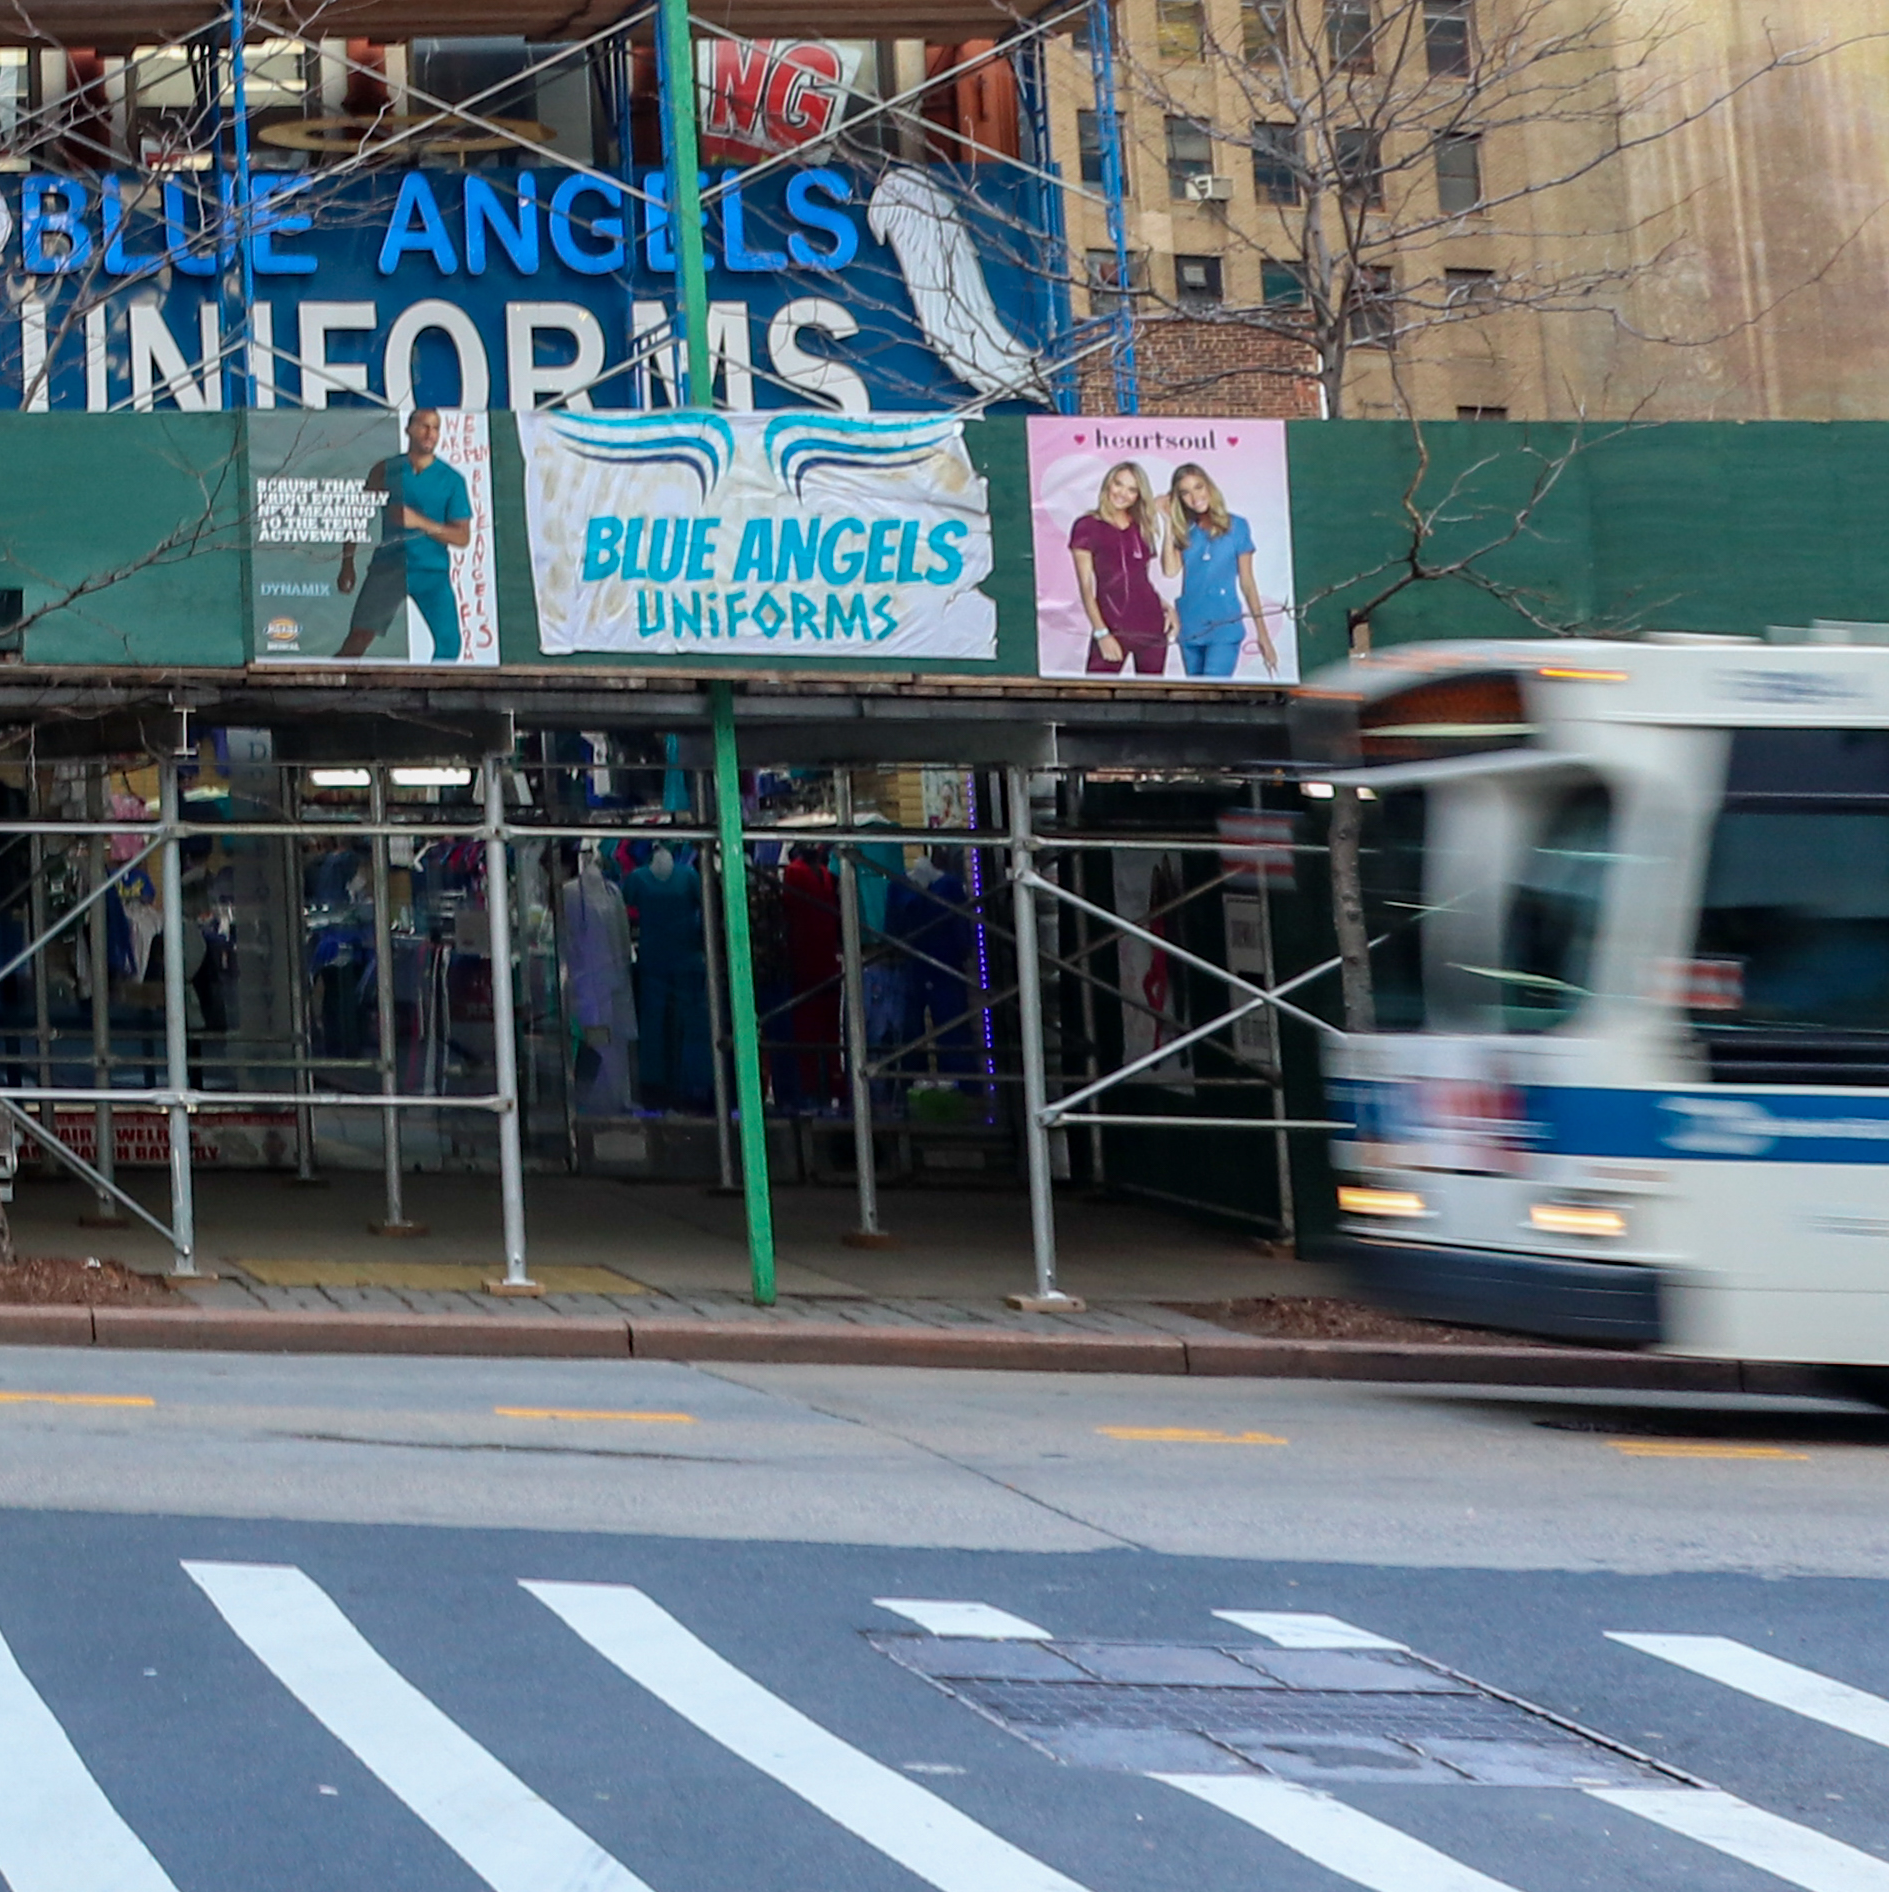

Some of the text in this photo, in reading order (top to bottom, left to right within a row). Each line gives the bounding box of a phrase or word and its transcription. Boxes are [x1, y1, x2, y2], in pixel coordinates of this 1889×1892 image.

[21, 168, 859, 277] BLUE ANGELS
[21, 297, 871, 412] UNIFORMS
[445, 414, 475, 433] WE
[1095, 428, 1218, 451] heartsoul
[257, 478, 367, 493] SCRUBS THAT
[312, 491, 390, 506] ENTIRELY
[258, 505, 376, 518] NEW MEANING
[259, 517, 367, 530] TO THE TERM
[258, 530, 372, 542] ACTIVEWEAR.
[582, 515, 969, 586] BLUE ANGELS
[261, 582, 330, 596] DYNAMIX
